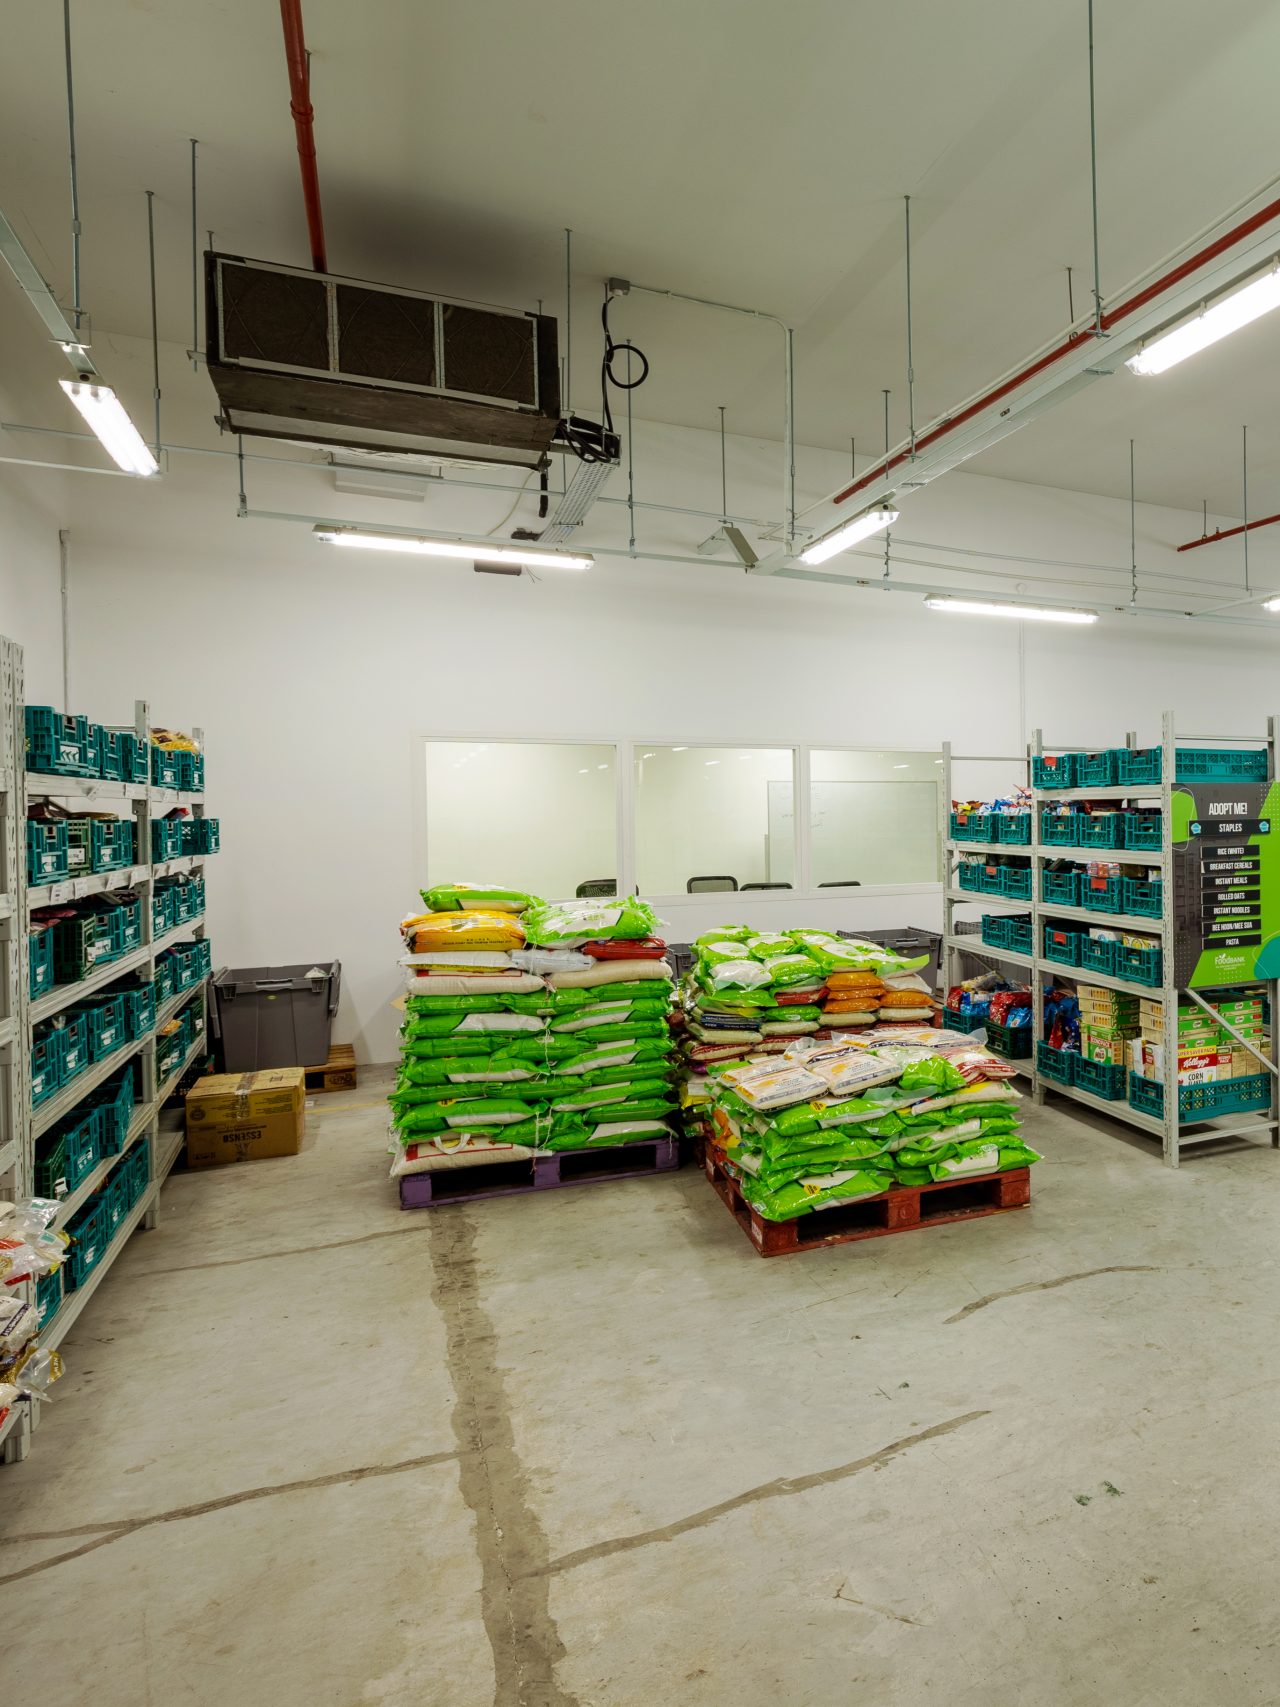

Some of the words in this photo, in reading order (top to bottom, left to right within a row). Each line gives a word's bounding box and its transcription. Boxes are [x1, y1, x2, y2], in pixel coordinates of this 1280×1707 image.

[1208, 802, 1233, 816] ADOPT
[1233, 802, 1248, 815] ME!
[1218, 823, 1243, 833] STAPLES
[1210, 862, 1234, 871] BREAKFAST
[1234, 861, 1253, 869] CEREALS
[1215, 877, 1233, 886] INSTANT
[1233, 876, 1248, 884] MEALS
[1217, 893, 1234, 901] ROLLED
[1233, 892, 1246, 900] OATS
[1213, 907, 1231, 915] INSTANT
[1231, 906, 1251, 914] NOODLES
[1211, 924, 1221, 932] BEE
[1225, 938, 1240, 946] PASTA
[1183, 1056, 1210, 1069] Kellogg's
[1188, 1072, 1204, 1081] CORN
